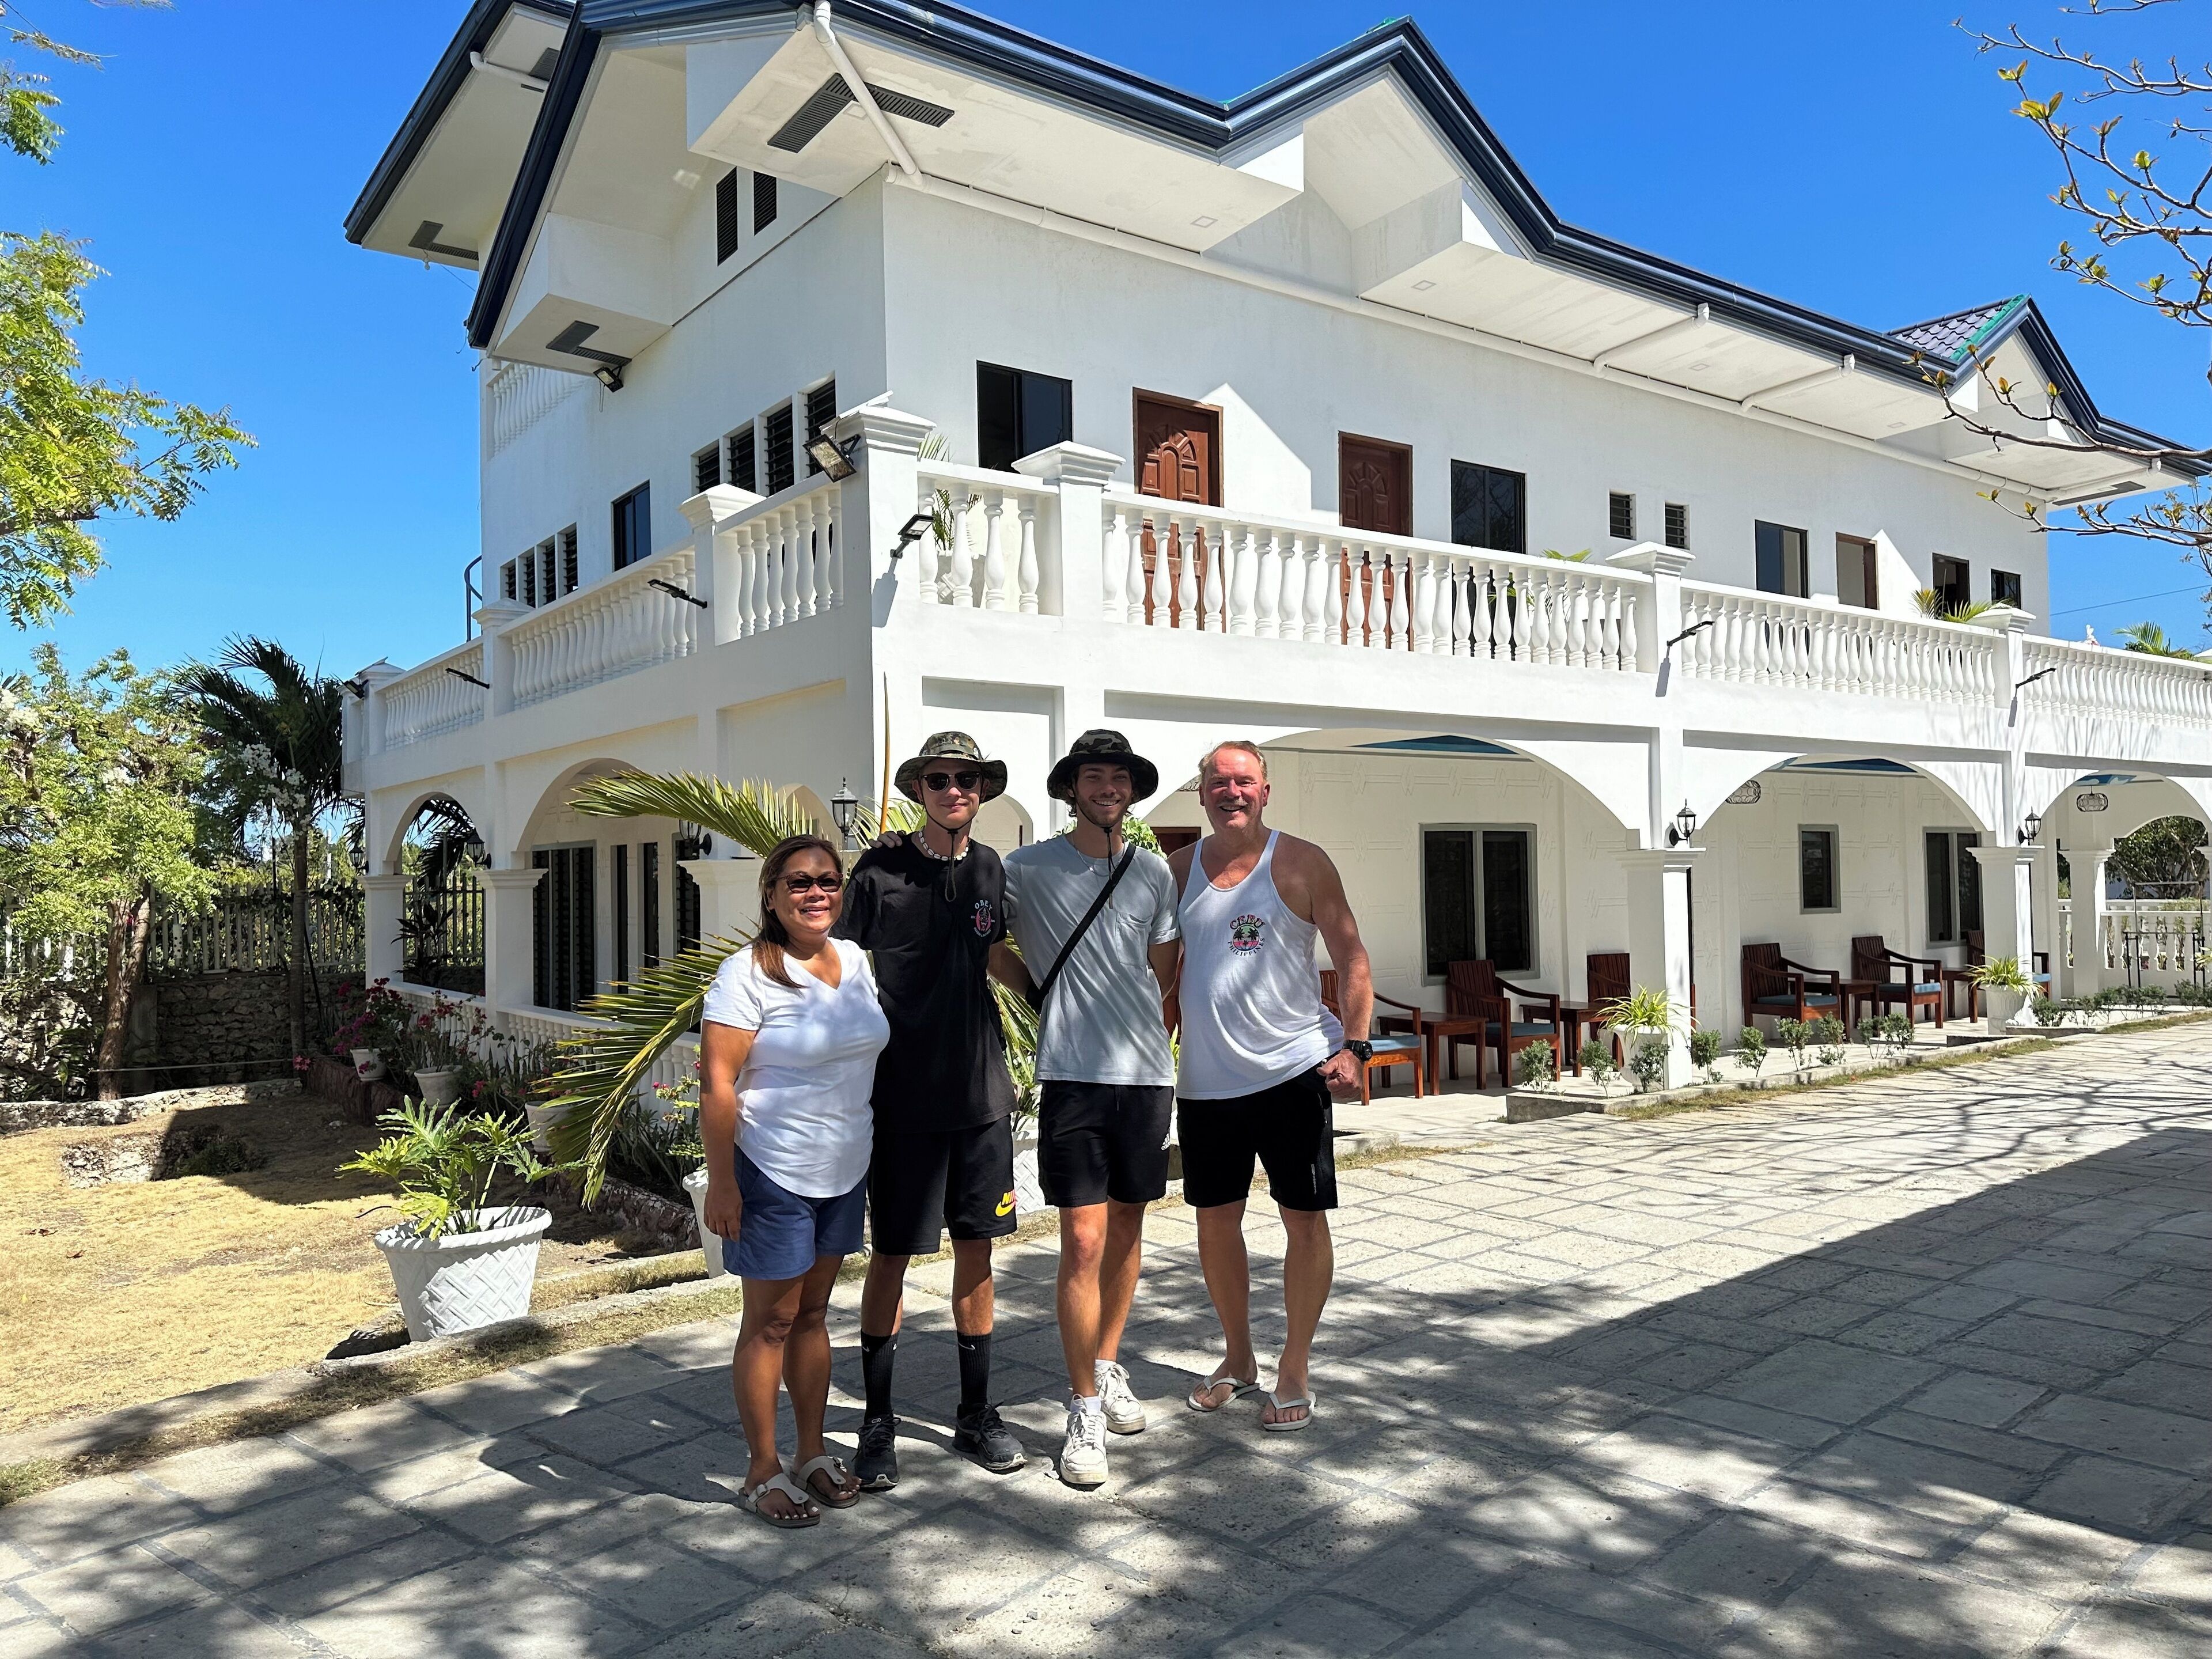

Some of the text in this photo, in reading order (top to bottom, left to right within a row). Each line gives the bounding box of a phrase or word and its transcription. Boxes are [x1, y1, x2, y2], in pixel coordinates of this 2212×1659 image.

[975, 900, 993, 910] OBEY
[1230, 914, 1266, 929] CEBU
[1228, 938, 1265, 956] PHILIPPINES
